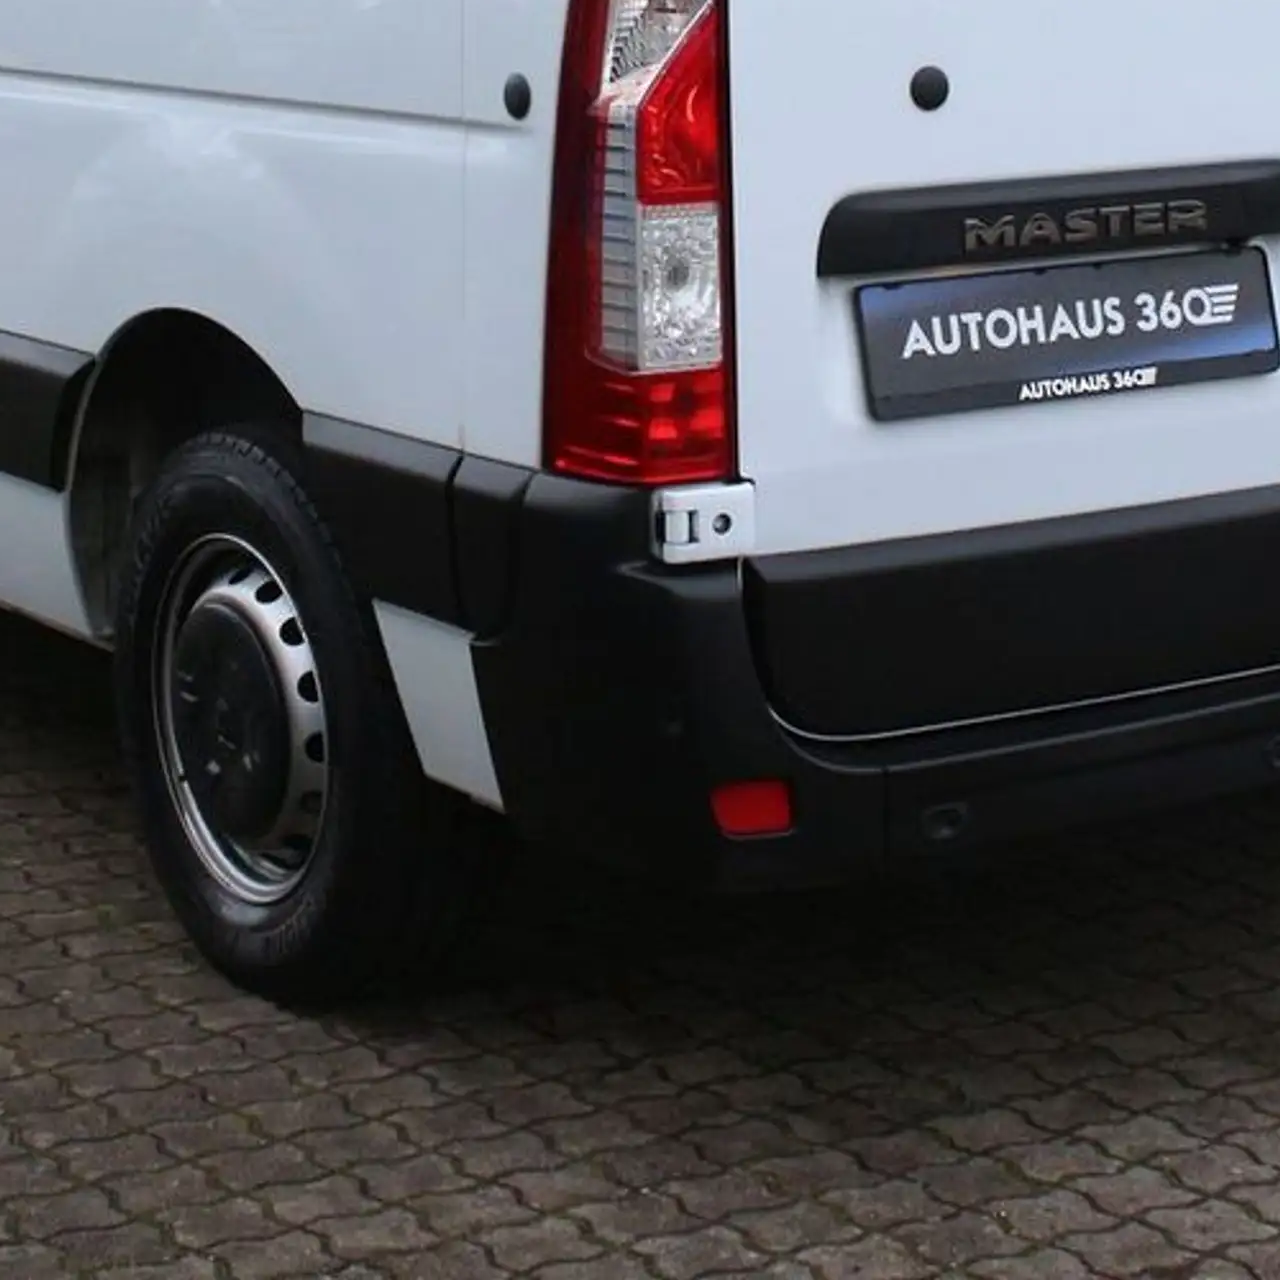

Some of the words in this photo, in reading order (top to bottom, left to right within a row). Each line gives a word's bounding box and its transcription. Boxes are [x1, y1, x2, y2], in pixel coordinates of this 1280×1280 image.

[963, 199, 1208, 252] MASTER
[900, 296, 1126, 360] AUTOHAUS
[1019, 373, 1110, 401] AUTOHAUS
